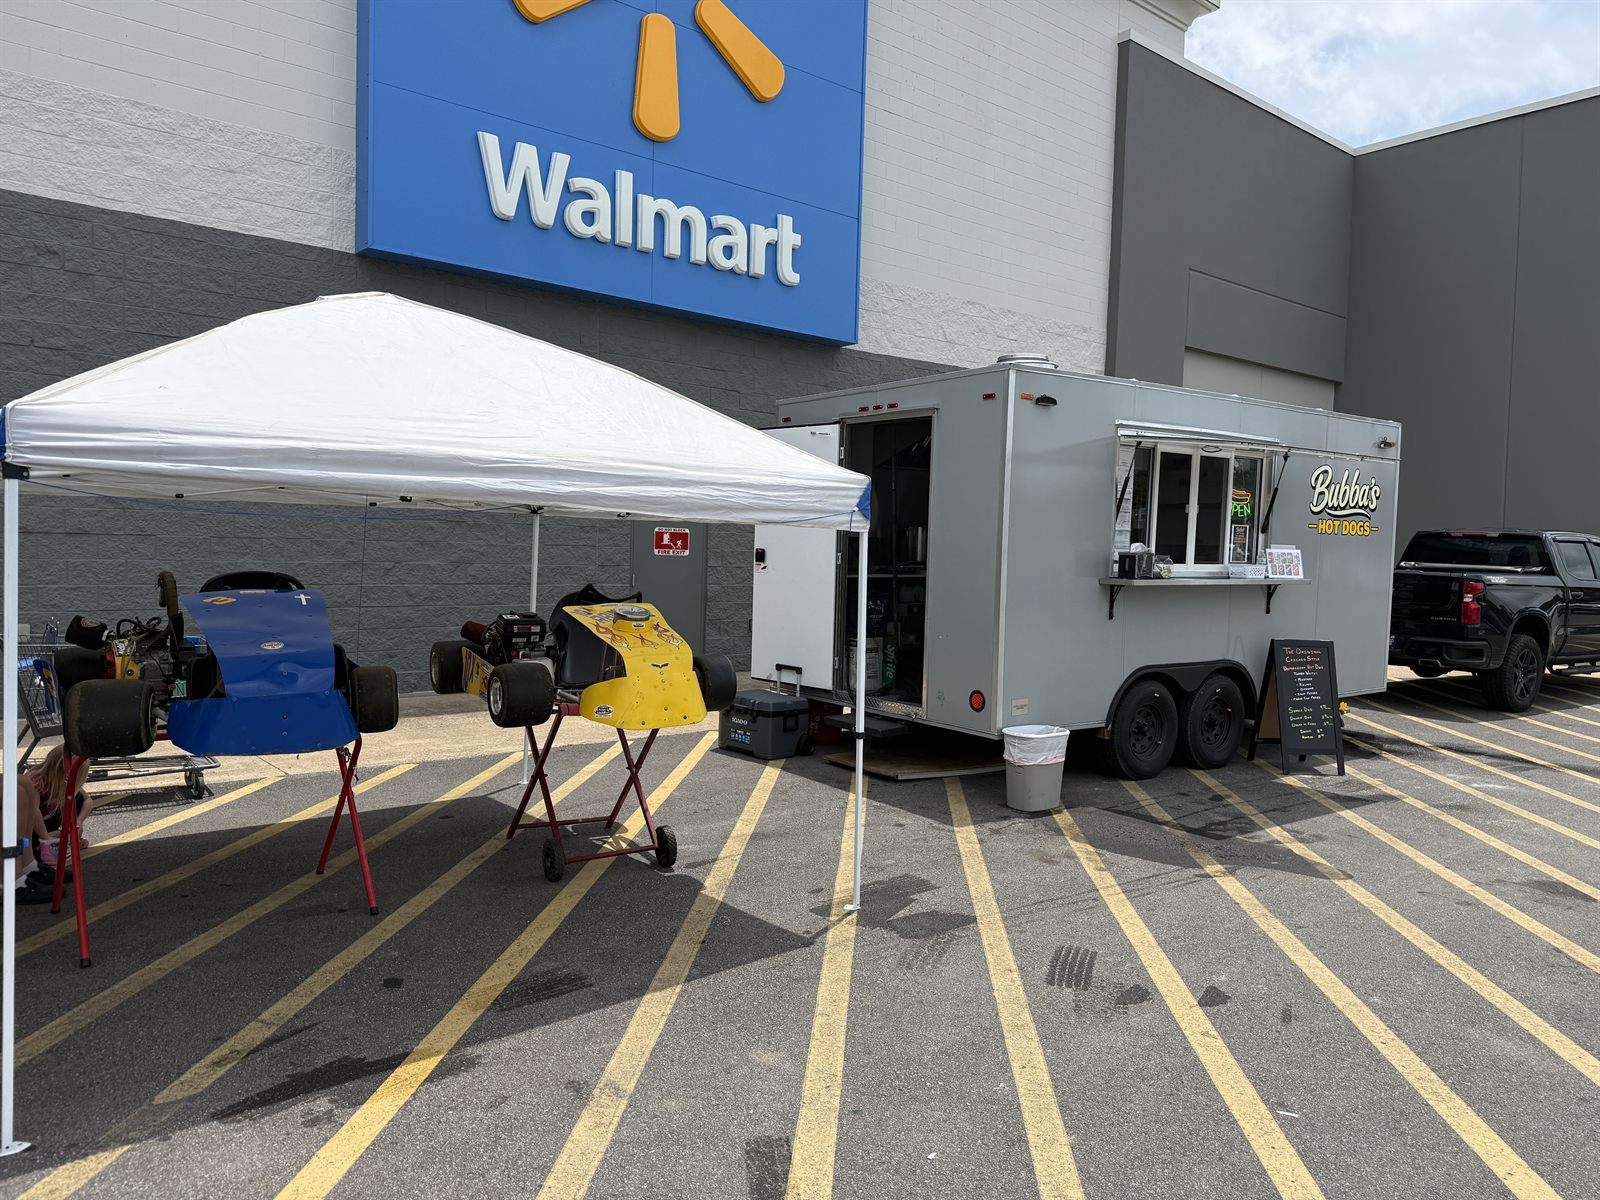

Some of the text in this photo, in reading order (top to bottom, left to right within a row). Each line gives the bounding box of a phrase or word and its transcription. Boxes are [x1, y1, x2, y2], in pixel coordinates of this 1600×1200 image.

[477, 131, 801, 287] Walmart
[1310, 464, 1380, 515] Bubba's
[1231, 503, 1251, 517] PEN
[1318, 519, 1371, 536] HOT DOGS
